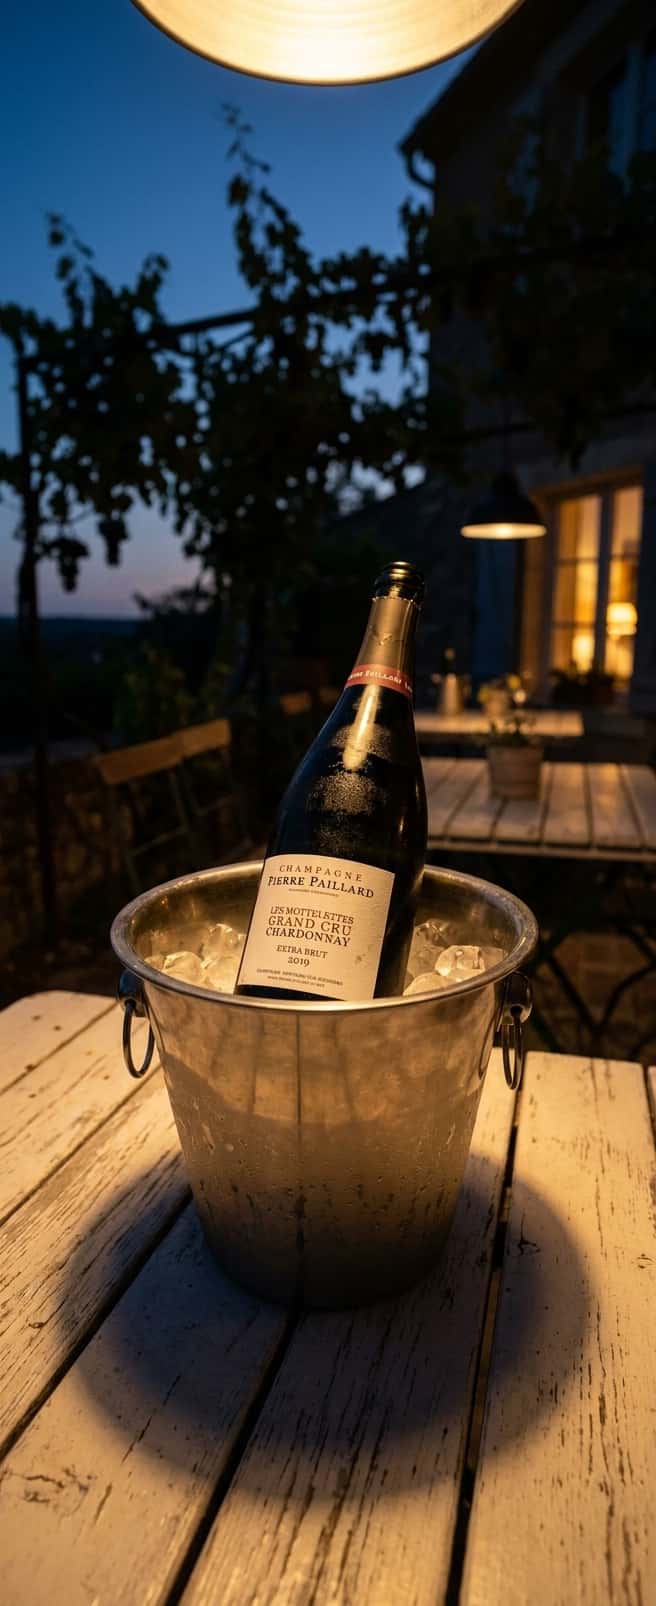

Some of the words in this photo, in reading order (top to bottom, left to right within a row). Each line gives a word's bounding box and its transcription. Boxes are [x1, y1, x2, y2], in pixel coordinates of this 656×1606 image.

[279, 864, 363, 882] CHAMPAGNE
[267, 876, 305, 887] PIERRE
[309, 876, 375, 898] PAILLARD
[268, 915, 315, 929] GRAND
[320, 921, 352, 937] CRU
[265, 927, 351, 947] CHARDONNAY
[287, 957, 310, 967] 2019
[304, 948, 328, 959] BRUT
